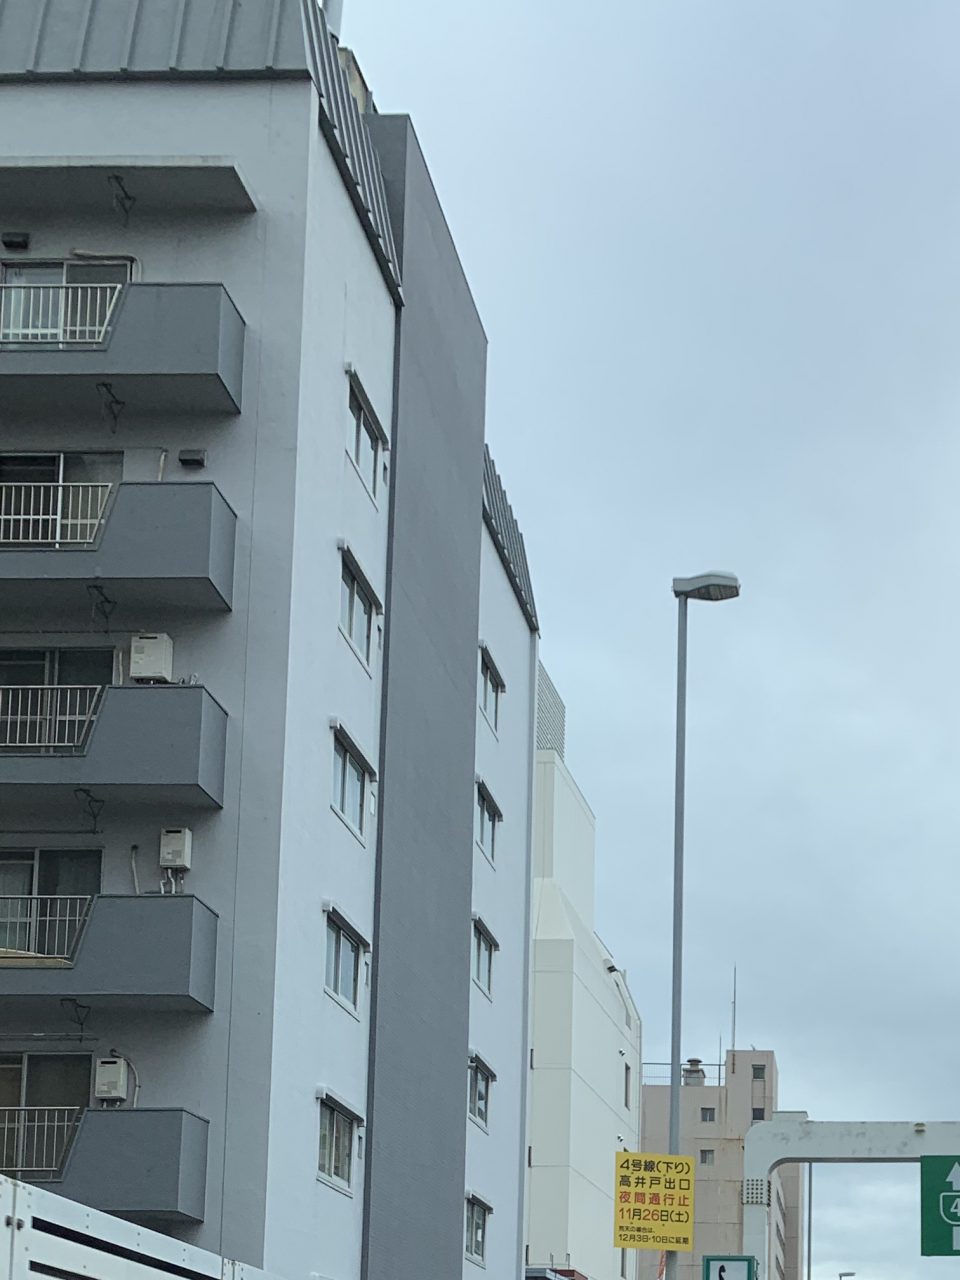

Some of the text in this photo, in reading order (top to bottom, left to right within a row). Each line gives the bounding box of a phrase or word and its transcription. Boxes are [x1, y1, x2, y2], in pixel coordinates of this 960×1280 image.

[620, 1158, 690, 1174] 4号線(下り)
[619, 1175, 690, 1191] 高井戸出口
[619, 1191, 690, 1207] 夜間通行止
[618, 1207, 690, 1224] 11月26日(土)
